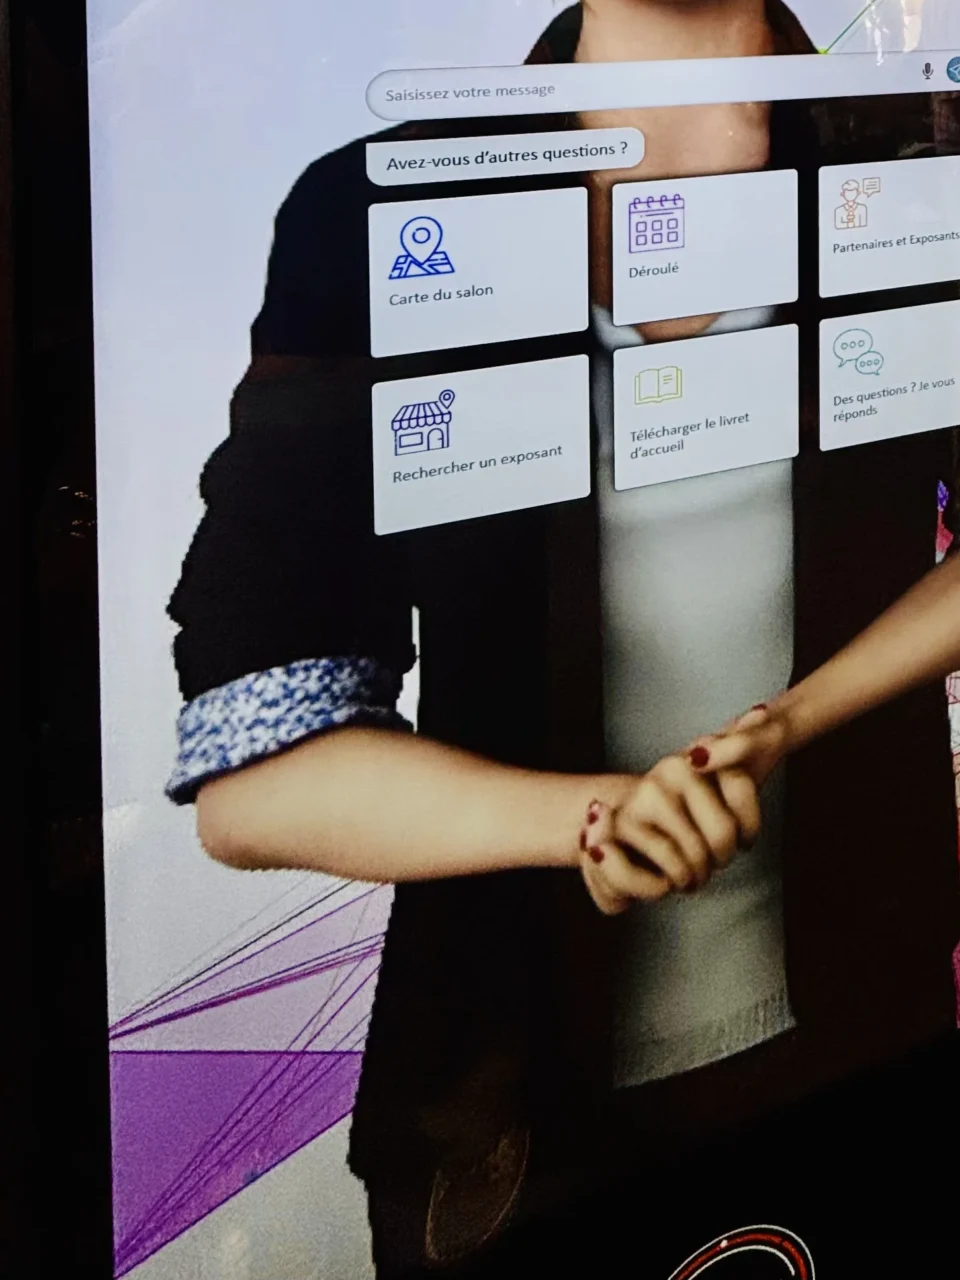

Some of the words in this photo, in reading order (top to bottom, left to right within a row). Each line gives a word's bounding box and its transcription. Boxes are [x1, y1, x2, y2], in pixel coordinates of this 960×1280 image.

[385, 89, 449, 102] Saisissez
[453, 86, 491, 99] votre
[495, 83, 556, 98] message
[386, 155, 470, 171] Avez-vous
[543, 144, 615, 162] questions
[620, 141, 628, 154] ?
[832, 237, 892, 254] Partenaires
[896, 236, 907, 246] et
[909, 230, 960, 245] Exposants
[628, 262, 680, 279] Déroulé
[389, 291, 429, 306] Carte
[433, 287, 452, 301] du
[456, 284, 494, 299] salon
[833, 394, 853, 406] Des
[856, 384, 908, 404] questions
[910, 381, 917, 392] ?
[919, 379, 930, 391] Je
[932, 377, 956, 387] vous
[833, 408, 878, 423] réponds
[630, 423, 702, 444] Télécharger
[705, 418, 716, 430] le
[719, 412, 750, 427] livret
[392, 460, 475, 483] Rechercher
[479, 458, 497, 469] un
[500, 445, 564, 467] exposant
